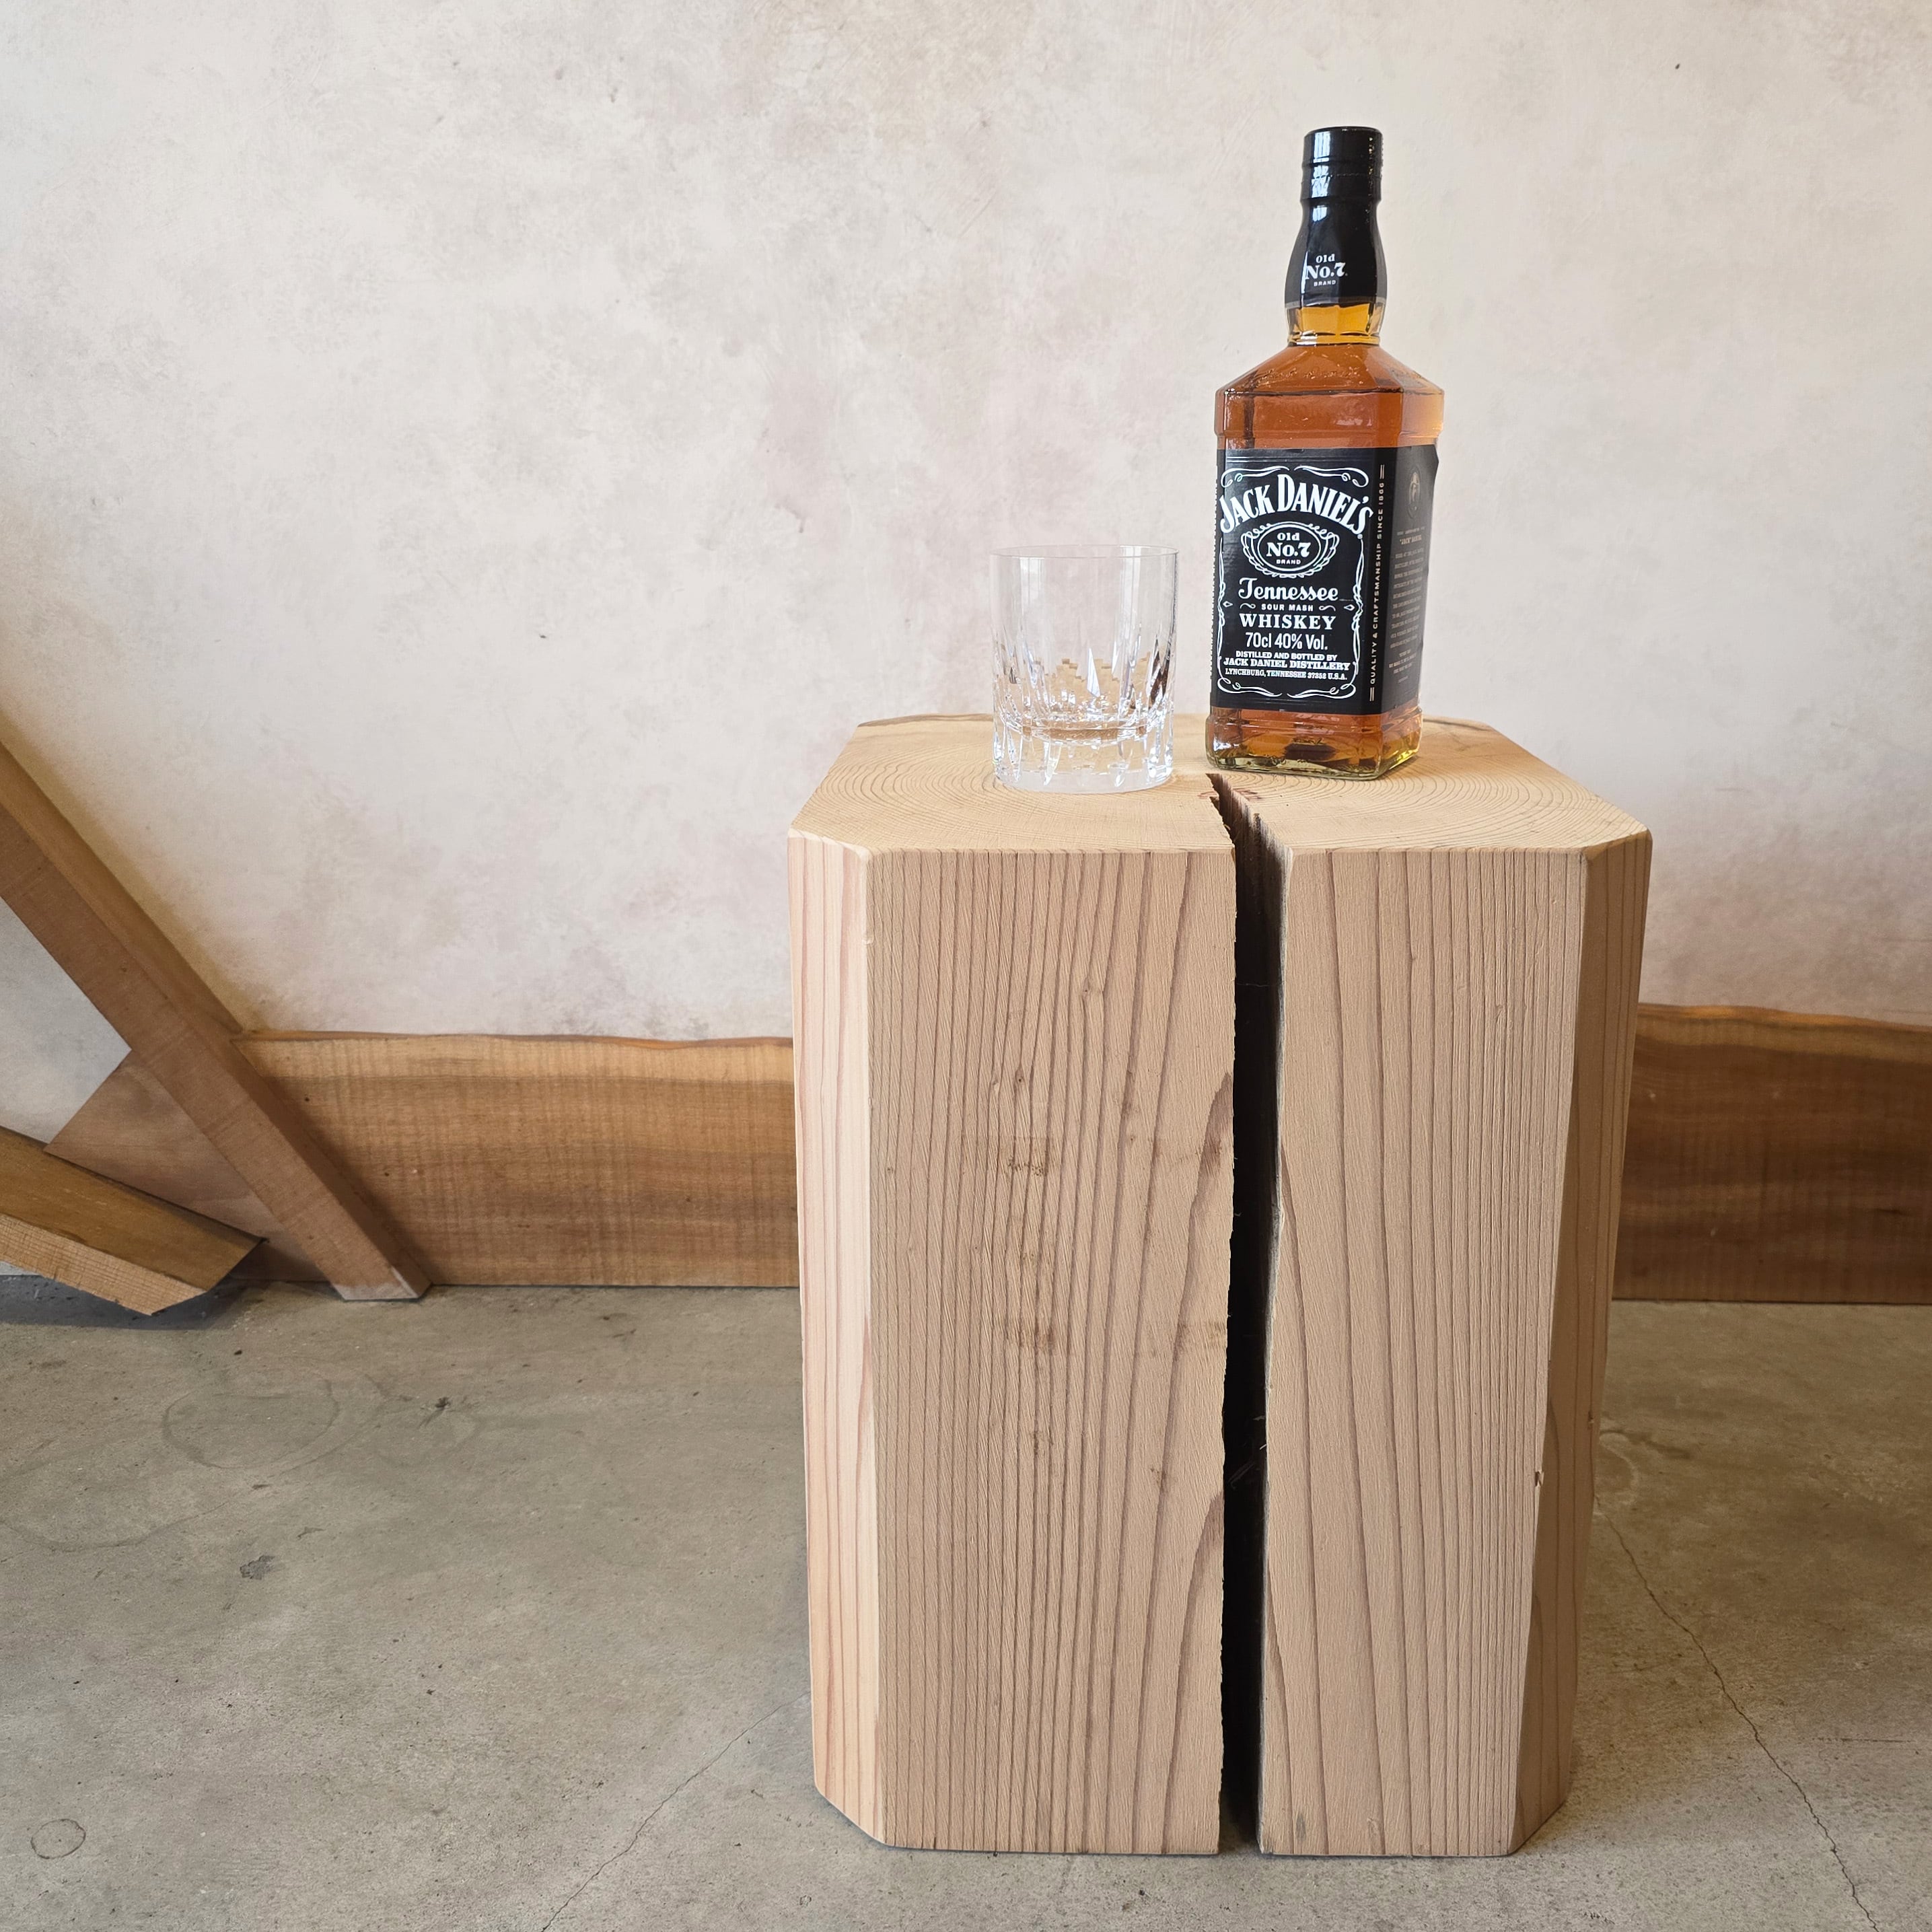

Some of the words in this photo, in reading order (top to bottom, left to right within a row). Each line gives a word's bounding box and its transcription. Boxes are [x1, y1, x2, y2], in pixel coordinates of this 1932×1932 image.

[1316, 254, 1335, 263] Old
[1305, 262, 1346, 279] No.7
[1219, 485, 1275, 533] JACK
[1277, 474, 1374, 534] DANIEL'S
[1277, 532, 1300, 541] Old
[1266, 542, 1312, 557] No.7
[1238, 577, 1338, 602] Tennessee
[1373, 543, 1382, 629] CRAFTSMANSHIP
[1239, 613, 1336, 630] WHISKEY
[1245, 632, 1272, 648] 70cl
[1274, 633, 1303, 649] 40%
[1305, 634, 1328, 650] Vol.
[1236, 650, 1273, 659] DISTILLED
[1291, 653, 1325, 661] BOTTLED
[1223, 657, 1249, 666] JACK
[1250, 659, 1288, 668] DANIEL
[1289, 660, 1351, 671] DISTILLERY
[1225, 668, 1266, 678] LYNCHBURG,
[1266, 670, 1307, 678] TENNESSEE
[1328, 672, 1348, 680] U.S.A.
